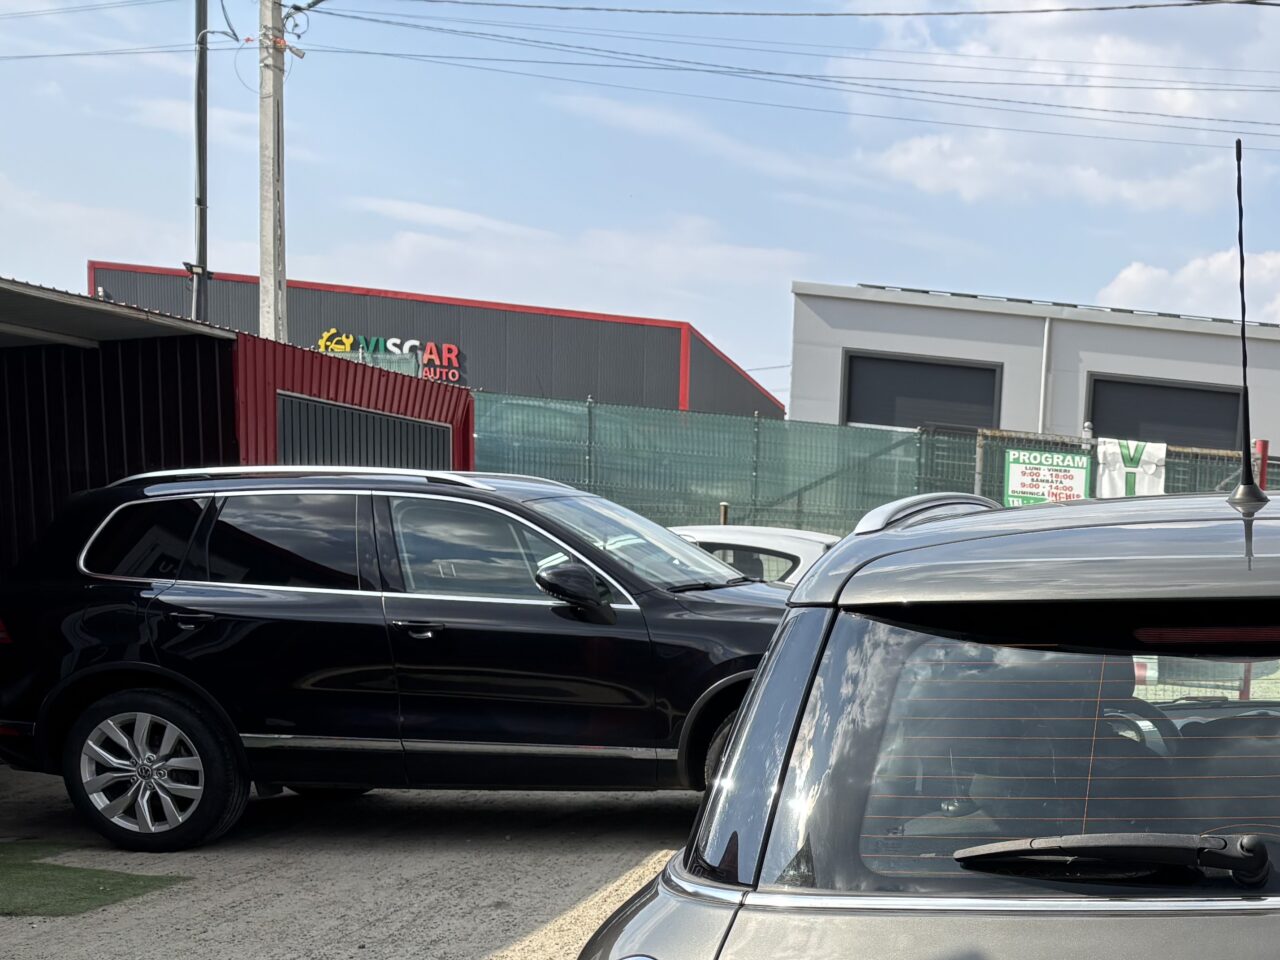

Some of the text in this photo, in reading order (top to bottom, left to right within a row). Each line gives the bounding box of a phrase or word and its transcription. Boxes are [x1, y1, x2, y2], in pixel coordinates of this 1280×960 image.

[422, 368, 459, 381] AUTO
[1009, 451, 1087, 468] PROGRAM
[1048, 484, 1073, 492] 14:00
